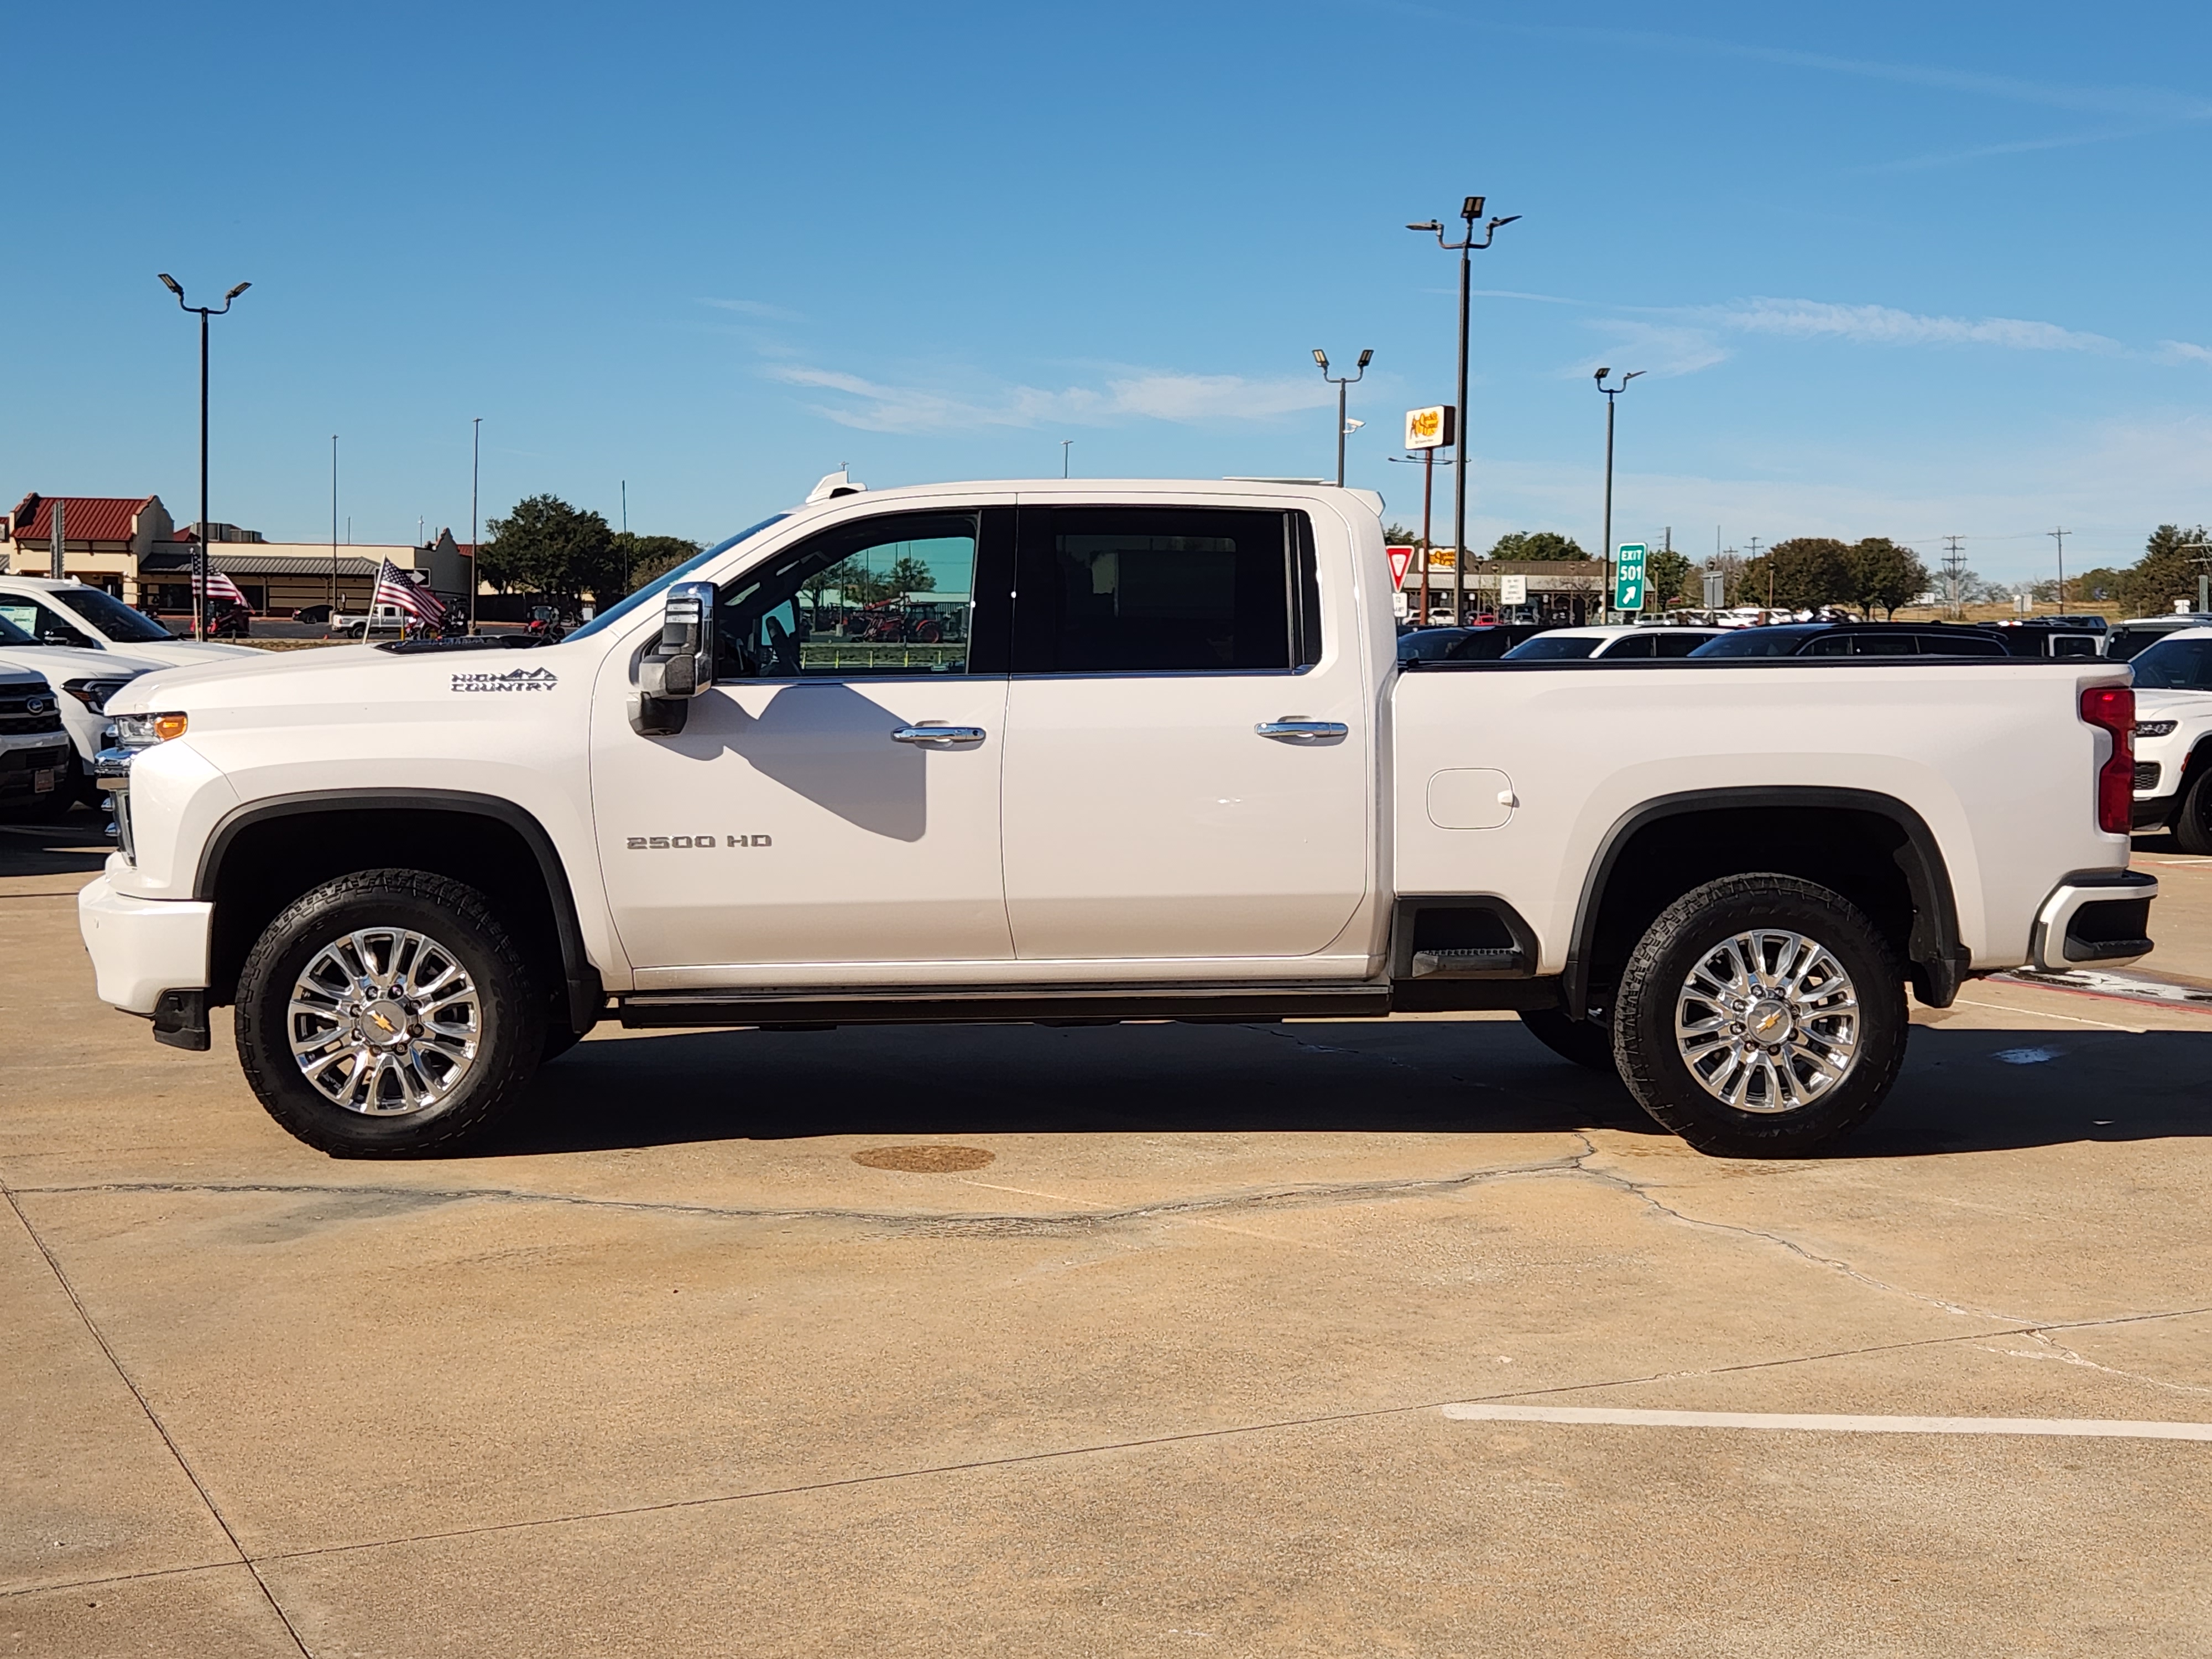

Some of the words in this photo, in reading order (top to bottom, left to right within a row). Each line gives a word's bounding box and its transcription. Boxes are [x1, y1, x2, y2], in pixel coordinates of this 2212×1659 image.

[1621, 550, 1642, 561] EXIT
[1620, 565, 1642, 581] 501
[451, 673, 507, 682] HIGH
[451, 682, 557, 692] COUNTRY
[627, 836, 716, 850] 2500
[727, 834, 772, 848] HD
